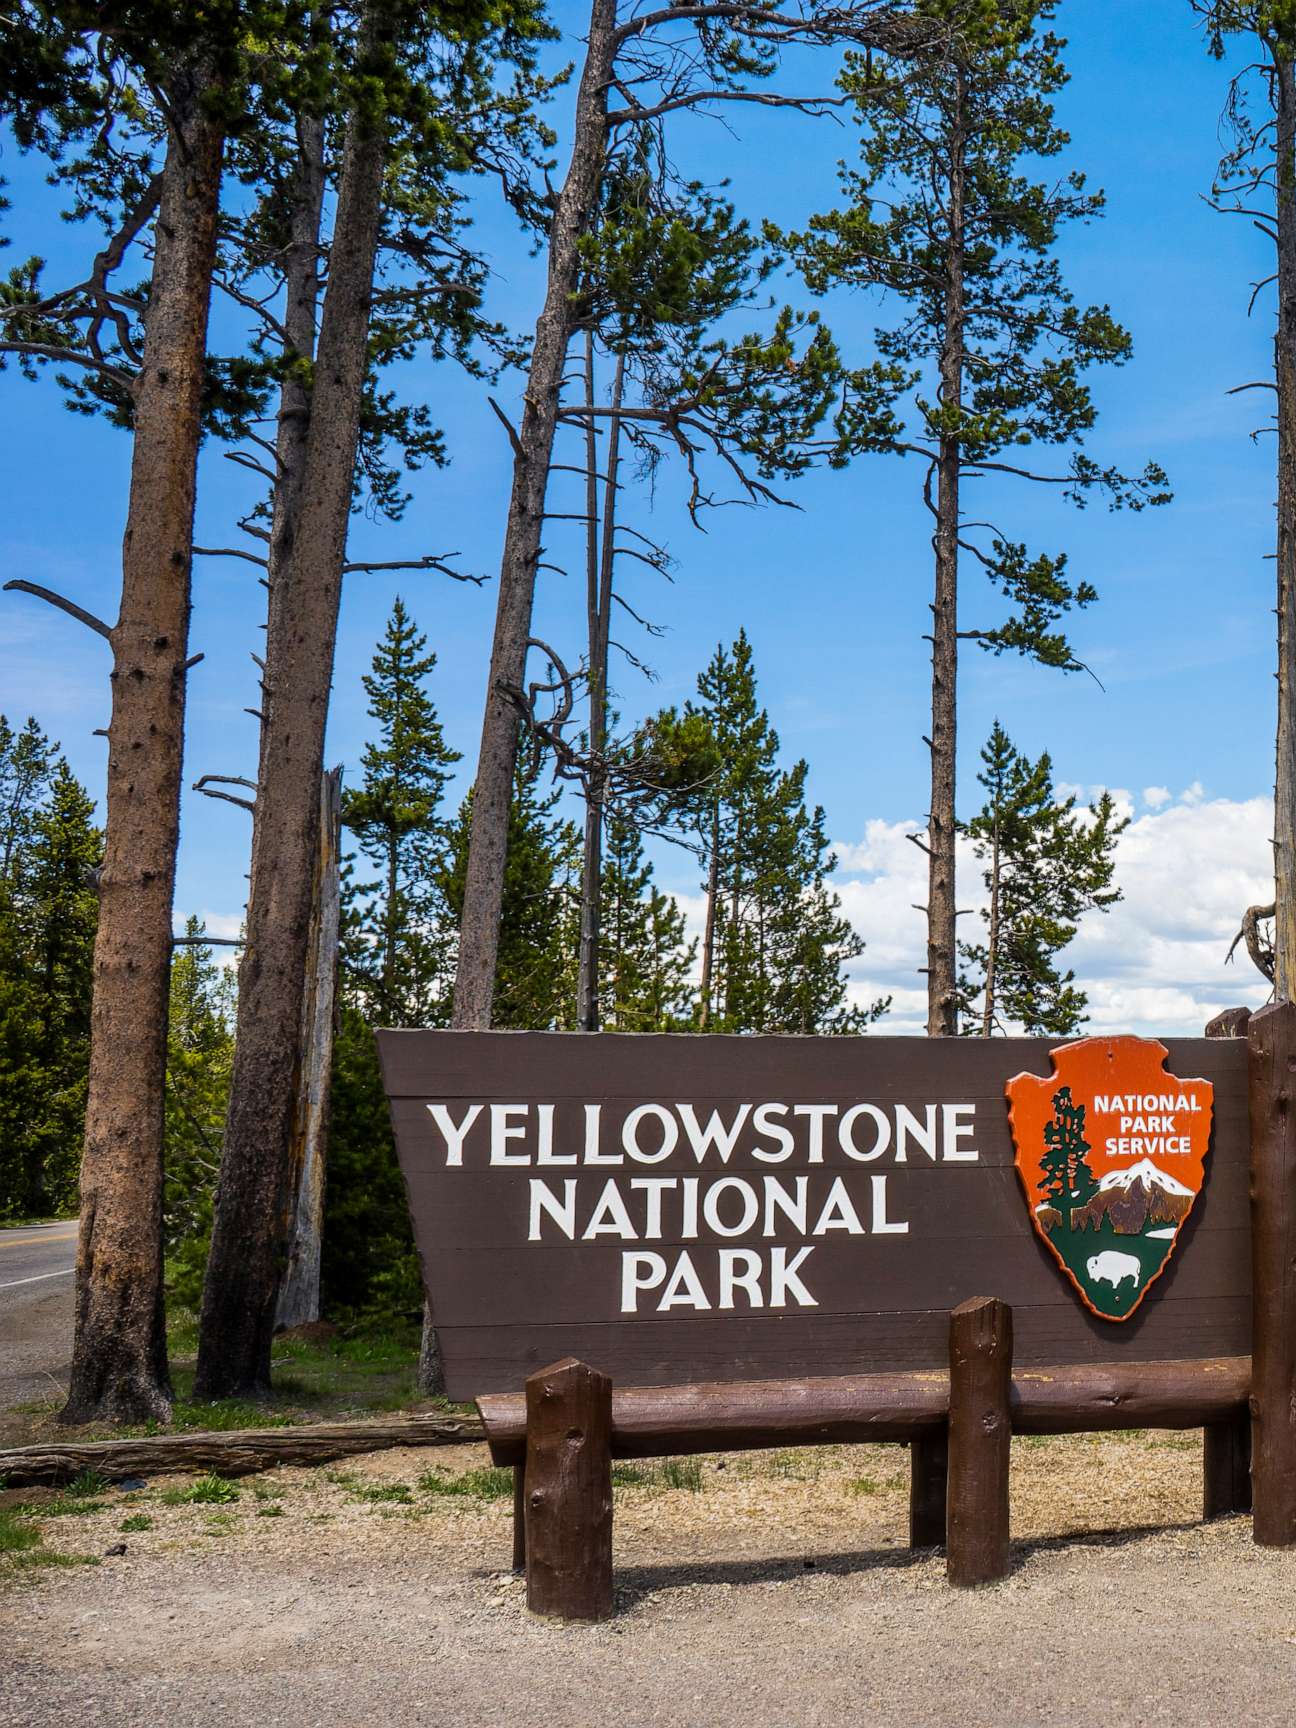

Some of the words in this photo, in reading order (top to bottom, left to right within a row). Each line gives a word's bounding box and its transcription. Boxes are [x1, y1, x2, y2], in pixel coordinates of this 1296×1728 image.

[1093, 1094, 1202, 1113] NATIONAL
[1120, 1115, 1175, 1134] PARK
[426, 1102, 979, 1167] YELLOWSTONE
[1105, 1136, 1191, 1155] SERVICE
[528, 1175, 909, 1241] NATIONAL
[620, 1246, 819, 1313] PARK
